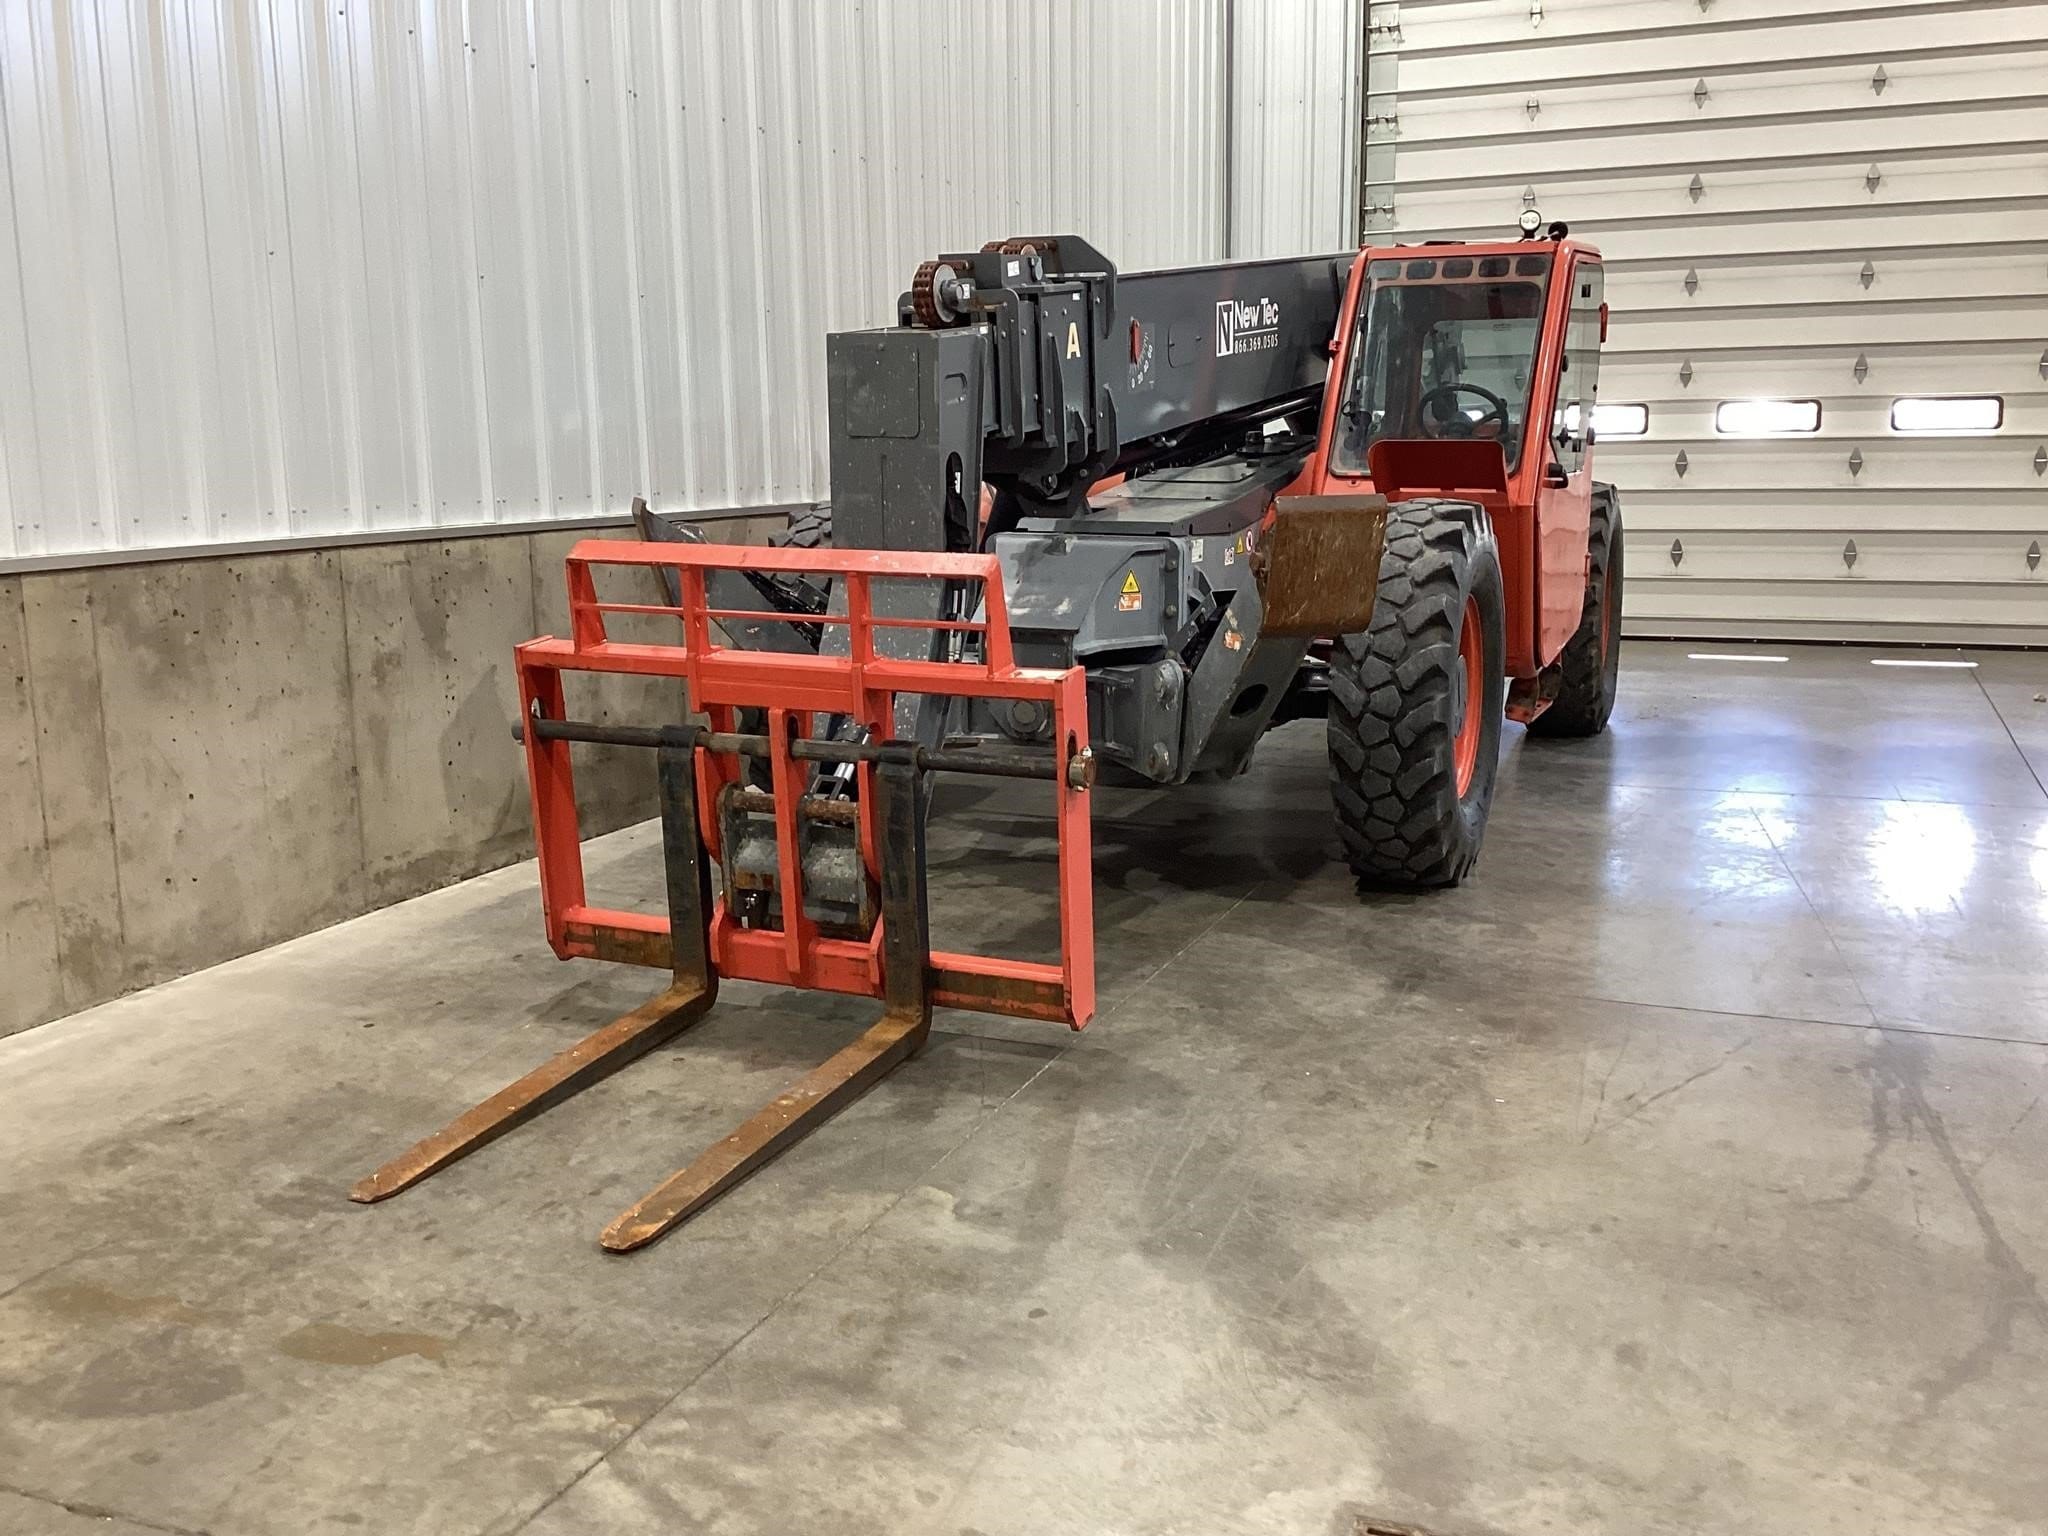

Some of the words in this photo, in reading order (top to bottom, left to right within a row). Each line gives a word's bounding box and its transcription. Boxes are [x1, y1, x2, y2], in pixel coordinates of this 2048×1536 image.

[1235, 300, 1260, 329] New
[1261, 298, 1278, 325] Tec
[1067, 322, 1081, 359] A
[1234, 334, 1278, 354] 866.369.0505
